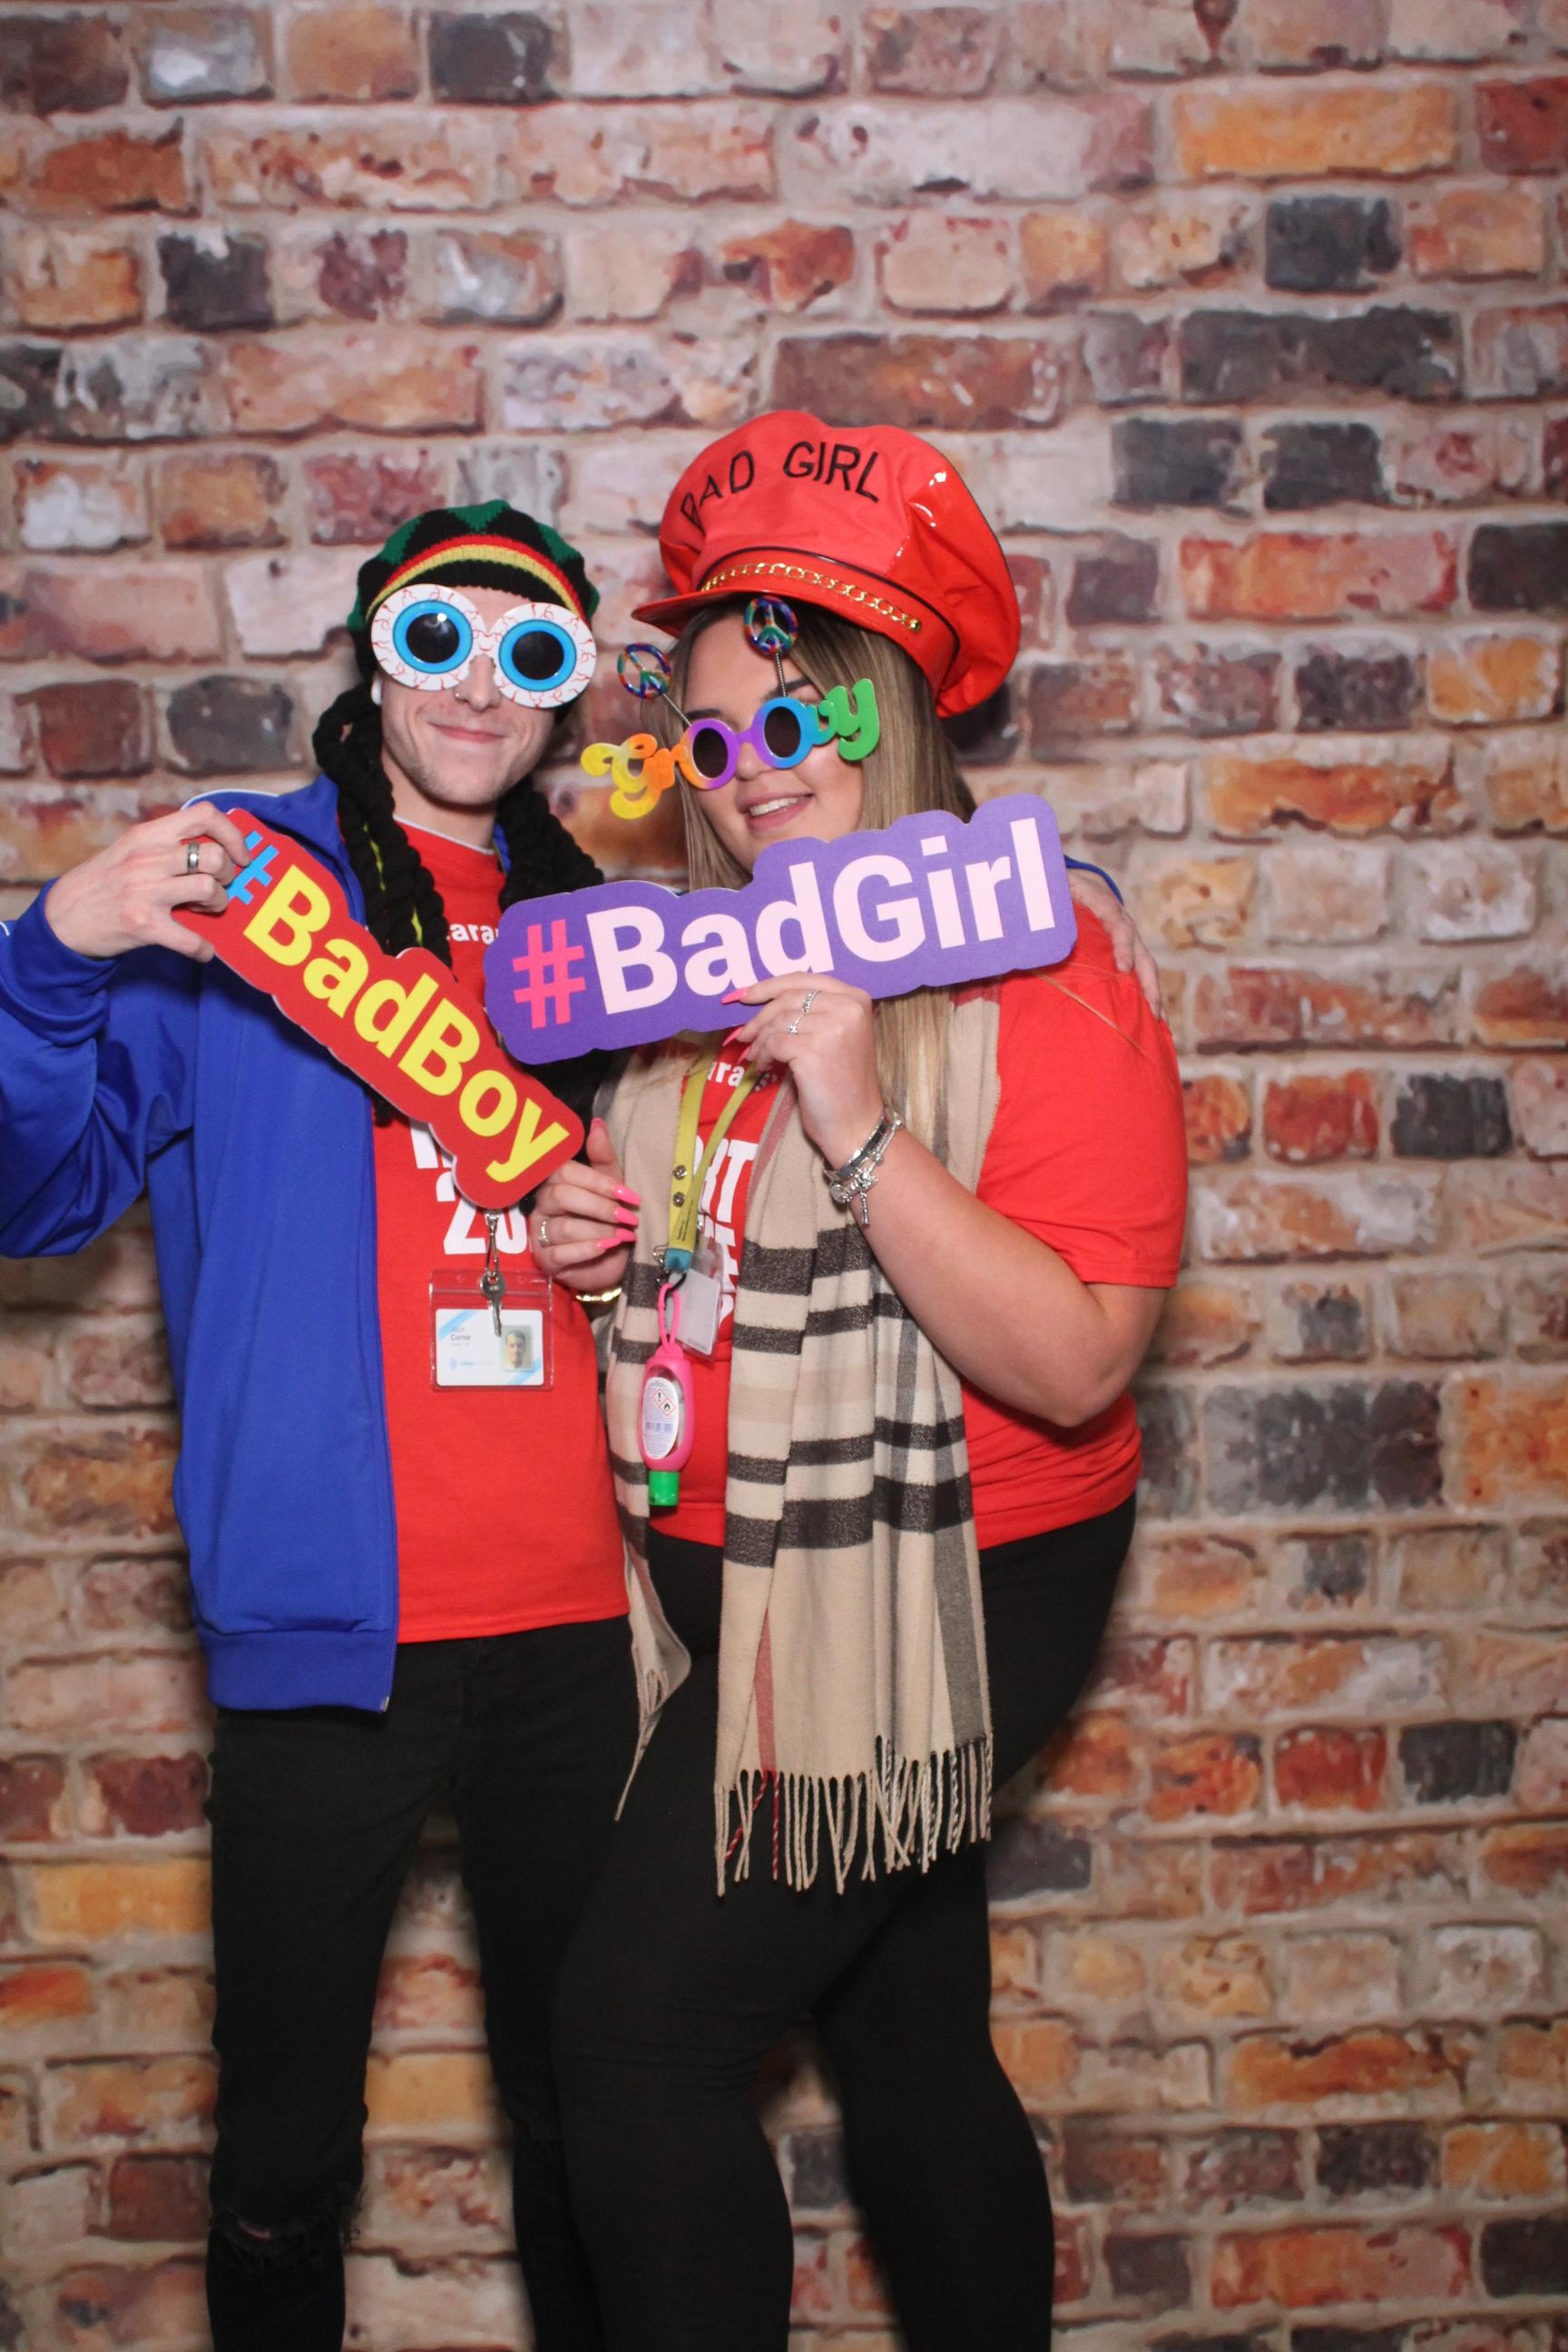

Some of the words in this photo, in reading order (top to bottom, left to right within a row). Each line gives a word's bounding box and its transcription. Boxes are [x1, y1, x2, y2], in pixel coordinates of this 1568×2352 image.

[783, 441, 878, 503] GIRL
[446, 924, 498, 945] ara
[512, 818, 1055, 1029] #BadGirl
